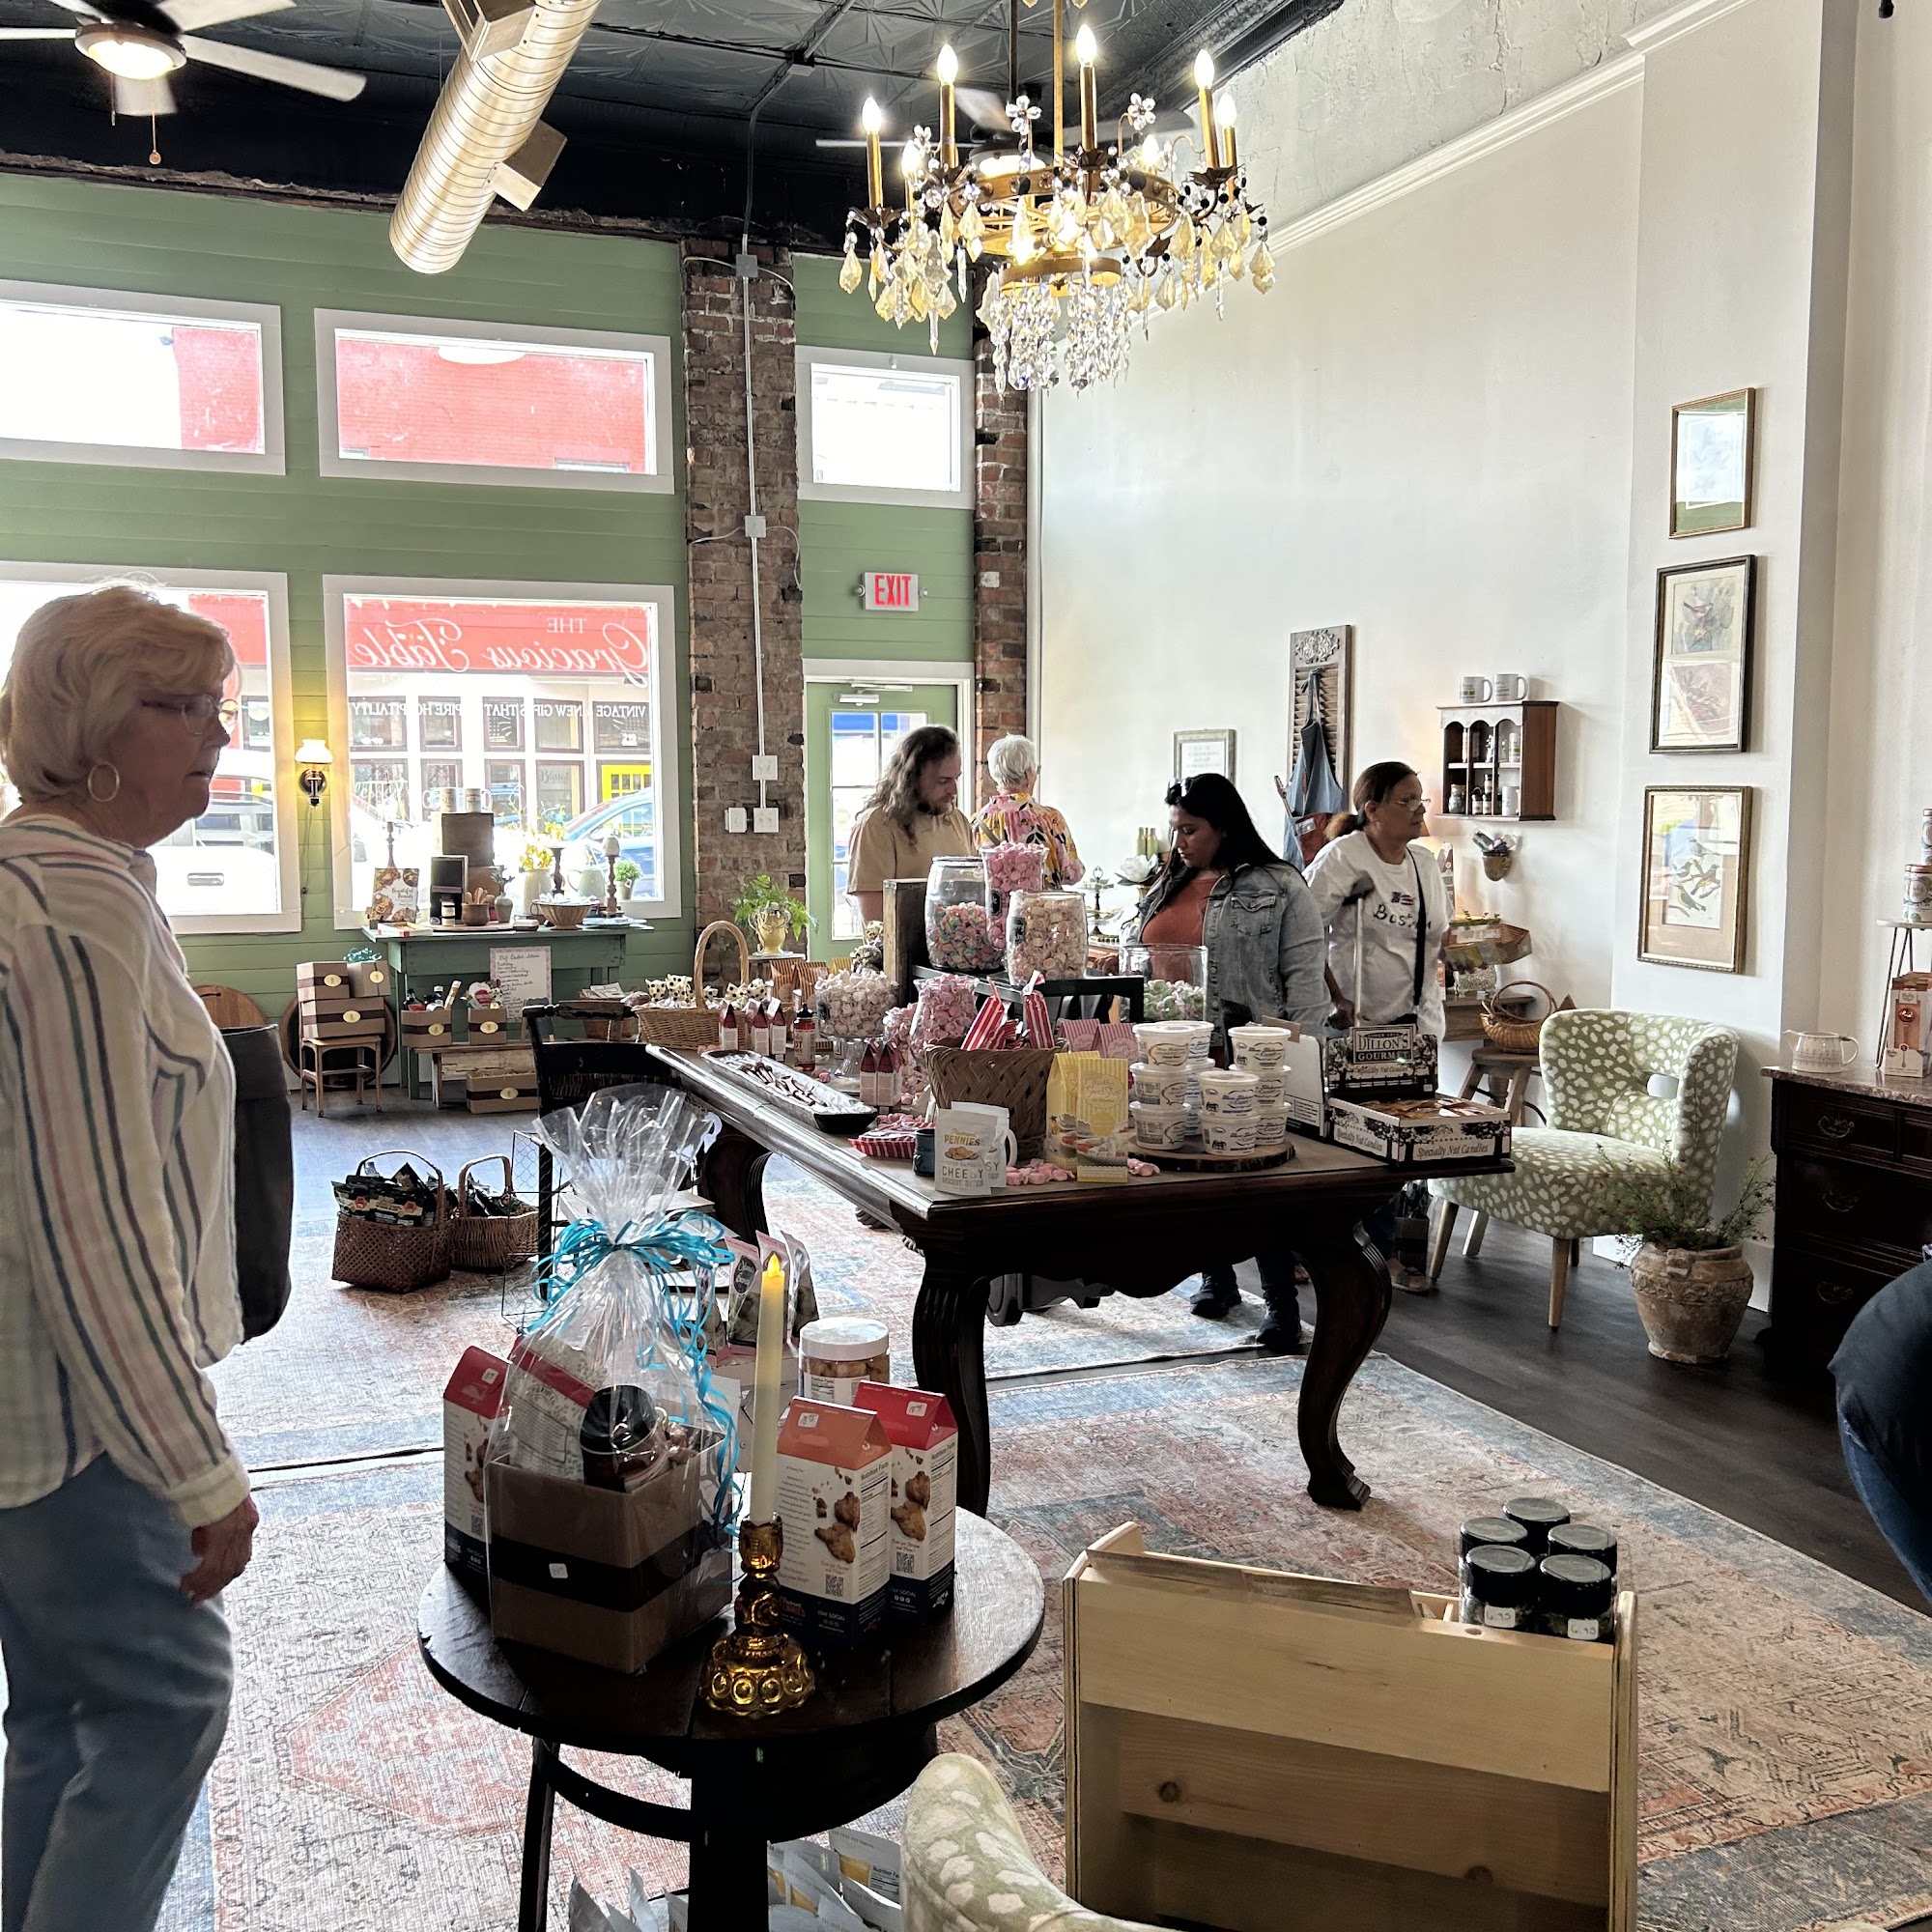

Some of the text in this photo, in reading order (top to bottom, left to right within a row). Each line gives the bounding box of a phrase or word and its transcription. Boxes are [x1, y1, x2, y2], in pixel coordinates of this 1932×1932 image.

[874, 575, 912, 607] EXIT
[1357, 1051, 1409, 1061] GOURMET
[944, 1134, 980, 1147] PENNIES
[1417, 1142, 1489, 1159] Specialty Nut Candies
[942, 1165, 983, 1179] CHEESY
[861, 1466, 878, 1481] Nutrition
